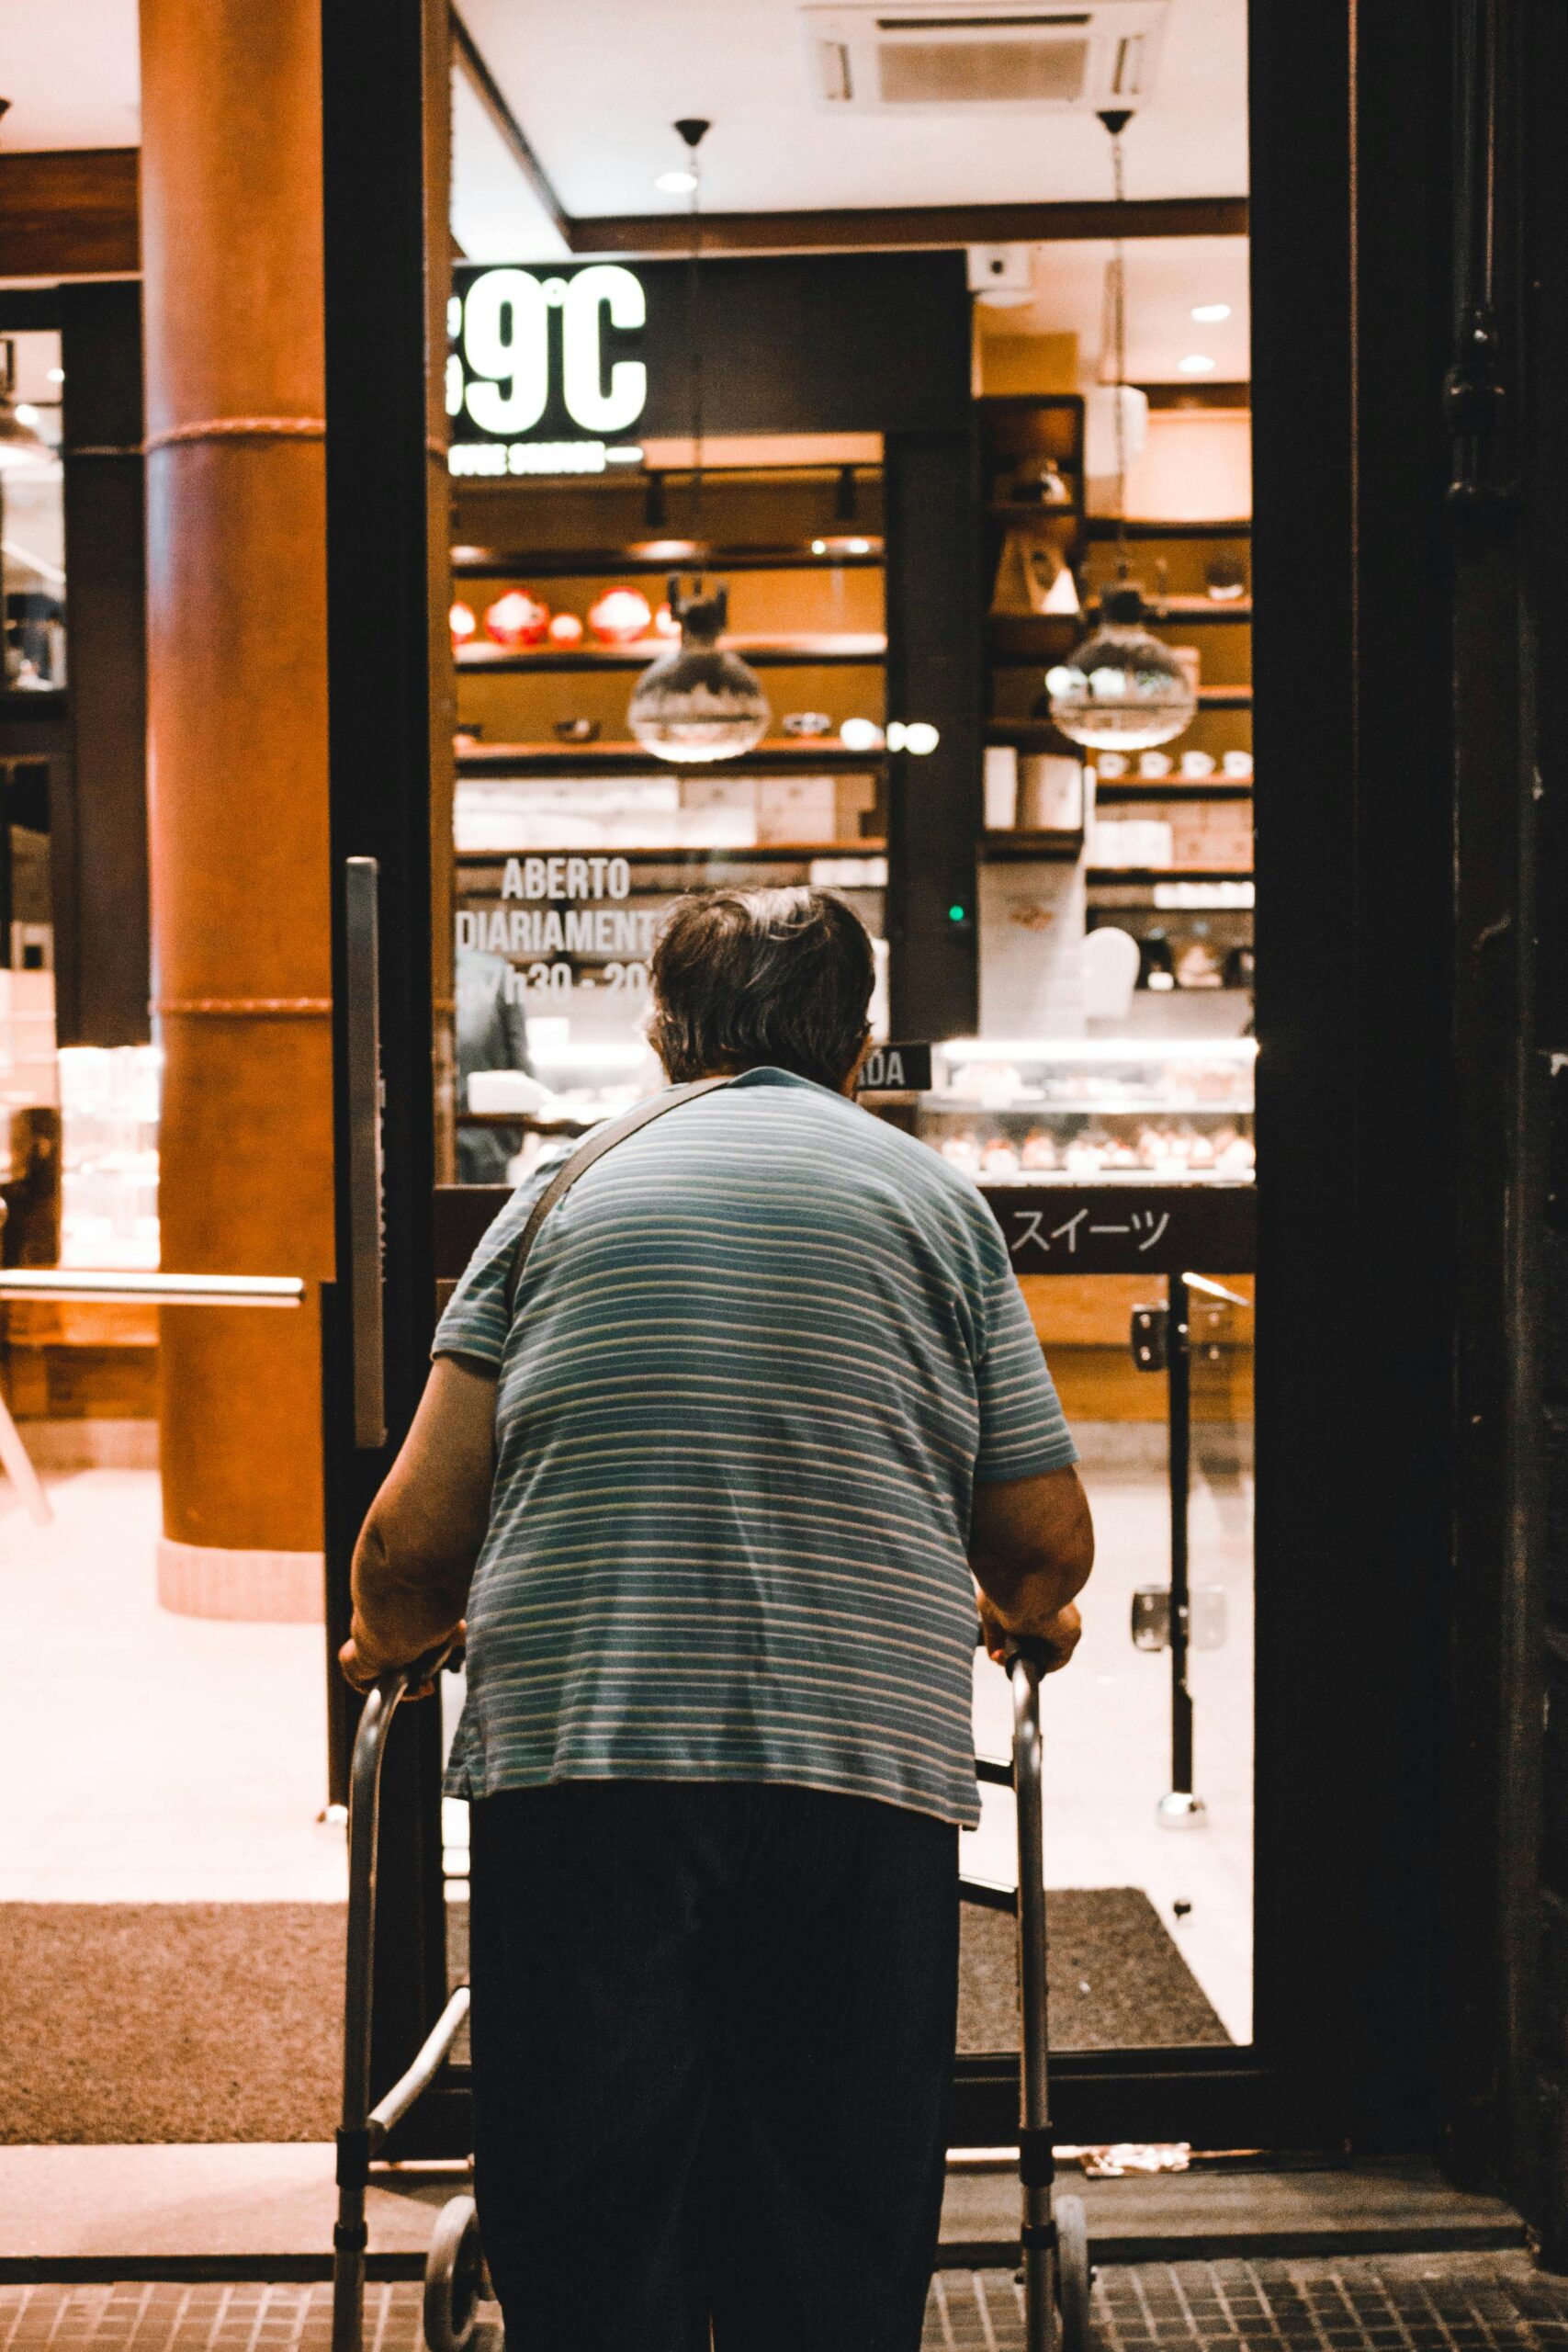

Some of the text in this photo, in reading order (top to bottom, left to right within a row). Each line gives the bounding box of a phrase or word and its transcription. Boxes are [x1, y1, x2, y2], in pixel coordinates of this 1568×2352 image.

[445, 264, 648, 435] 9°C
[501, 856, 631, 900] ABERTO
[456, 910, 657, 953] DIARIAMENT
[1010, 1207, 1171, 1254] スイーツ
